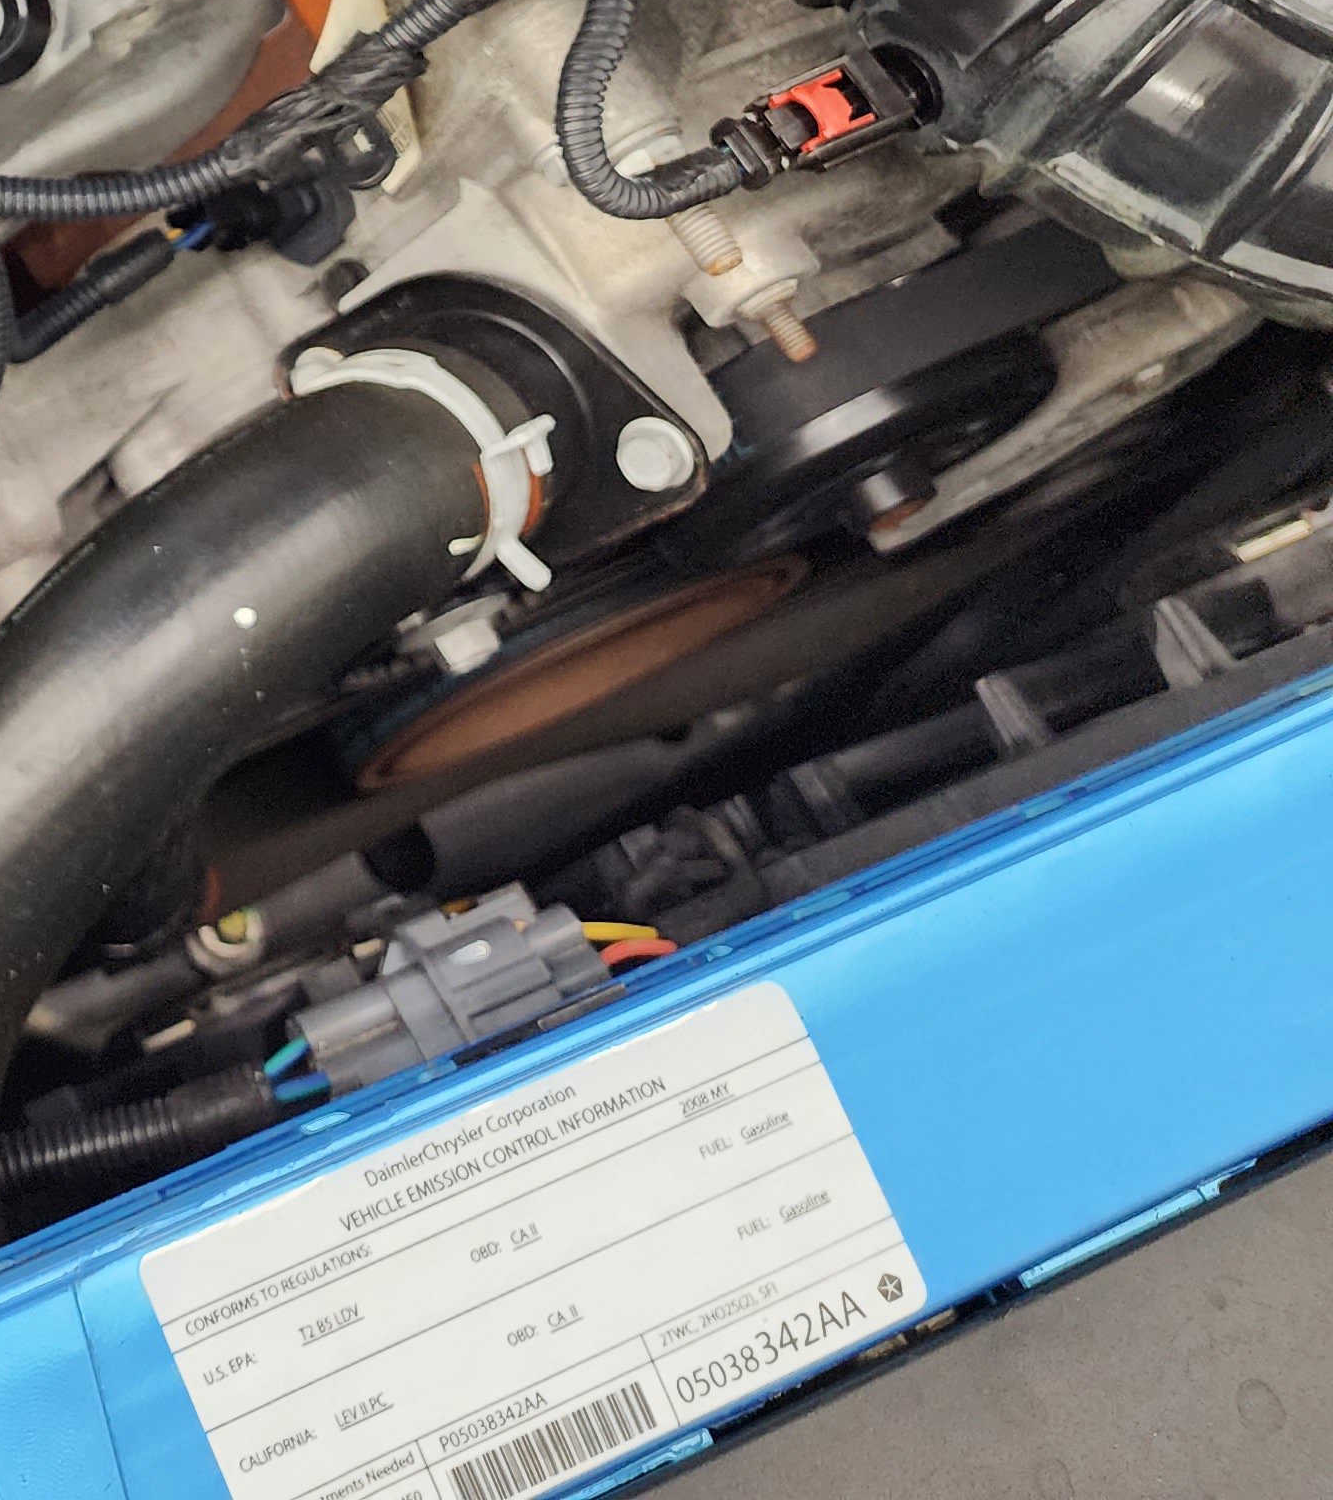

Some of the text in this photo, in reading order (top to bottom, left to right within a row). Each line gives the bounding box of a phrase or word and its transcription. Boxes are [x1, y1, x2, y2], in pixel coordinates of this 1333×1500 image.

[678, 1082, 731, 1115] 2008 MY
[340, 1076, 666, 1232] VEHICLE EMISSION CONTROL INFORMATION
[364, 1085, 577, 1188] DaimlerChrysler Corporation
[699, 1110, 790, 1160] FUEL: Gasoline
[736, 1190, 830, 1240] FUEL: Gasoline
[470, 1240, 502, 1264] OBD:
[510, 1228, 529, 1247] CA
[185, 1243, 373, 1336] CONFORMS TO REGULATIONS:
[298, 1323, 316, 1341] T2
[334, 1303, 360, 1326] LDV
[507, 1324, 539, 1347] OBD:
[547, 1311, 567, 1328] CA
[203, 1352, 258, 1386] U.S. EPA:
[676, 1291, 867, 1403] 05038342AA
[334, 1392, 389, 1429] LEV II PC
[439, 1391, 547, 1453] P05038342AA
[239, 1428, 317, 1473] CALIFORNIA:
[366, 1451, 414, 1484] Needed
